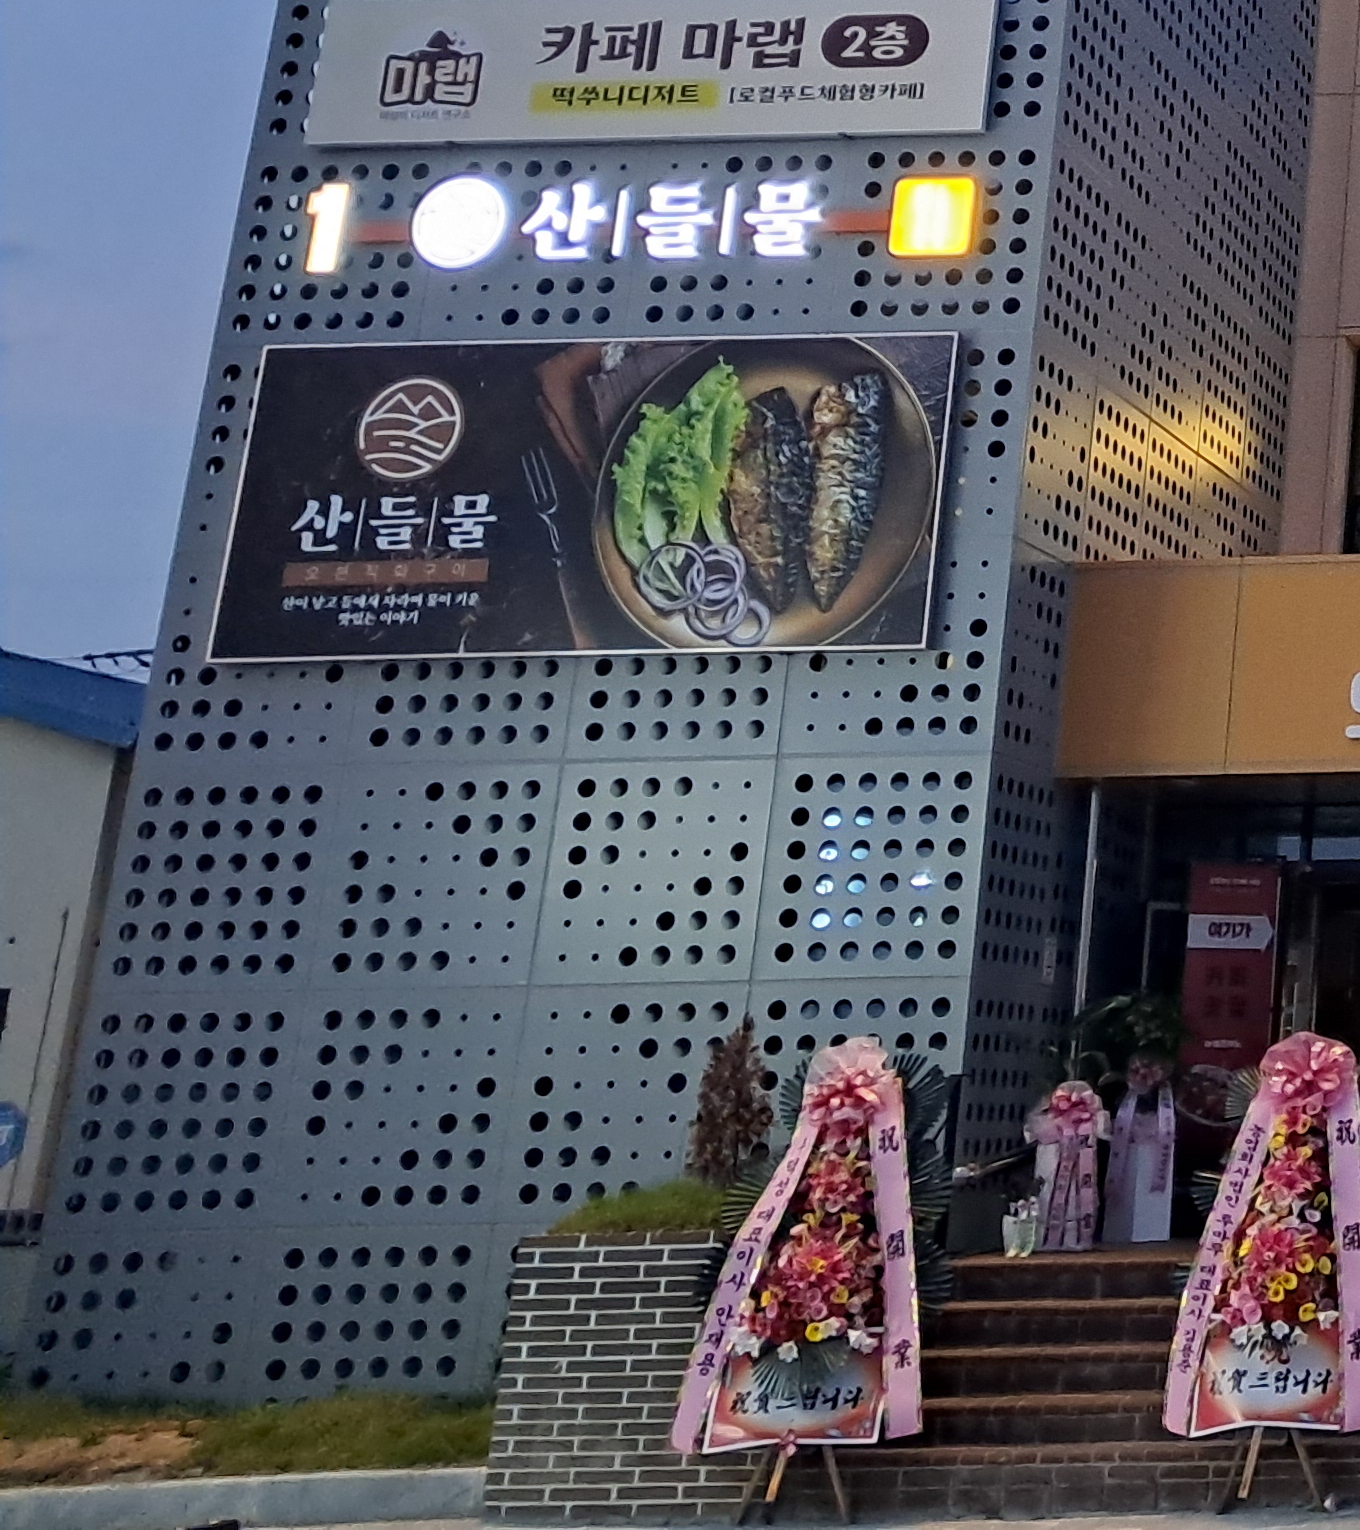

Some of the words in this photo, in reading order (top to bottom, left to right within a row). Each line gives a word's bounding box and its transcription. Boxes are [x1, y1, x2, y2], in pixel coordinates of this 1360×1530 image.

[534, 20, 662, 74] 카페
[681, 16, 806, 70] 마랩
[838, 21, 910, 60] 2층
[380, 55, 484, 108] 마랩
[380, 610, 419, 625] 이야기
